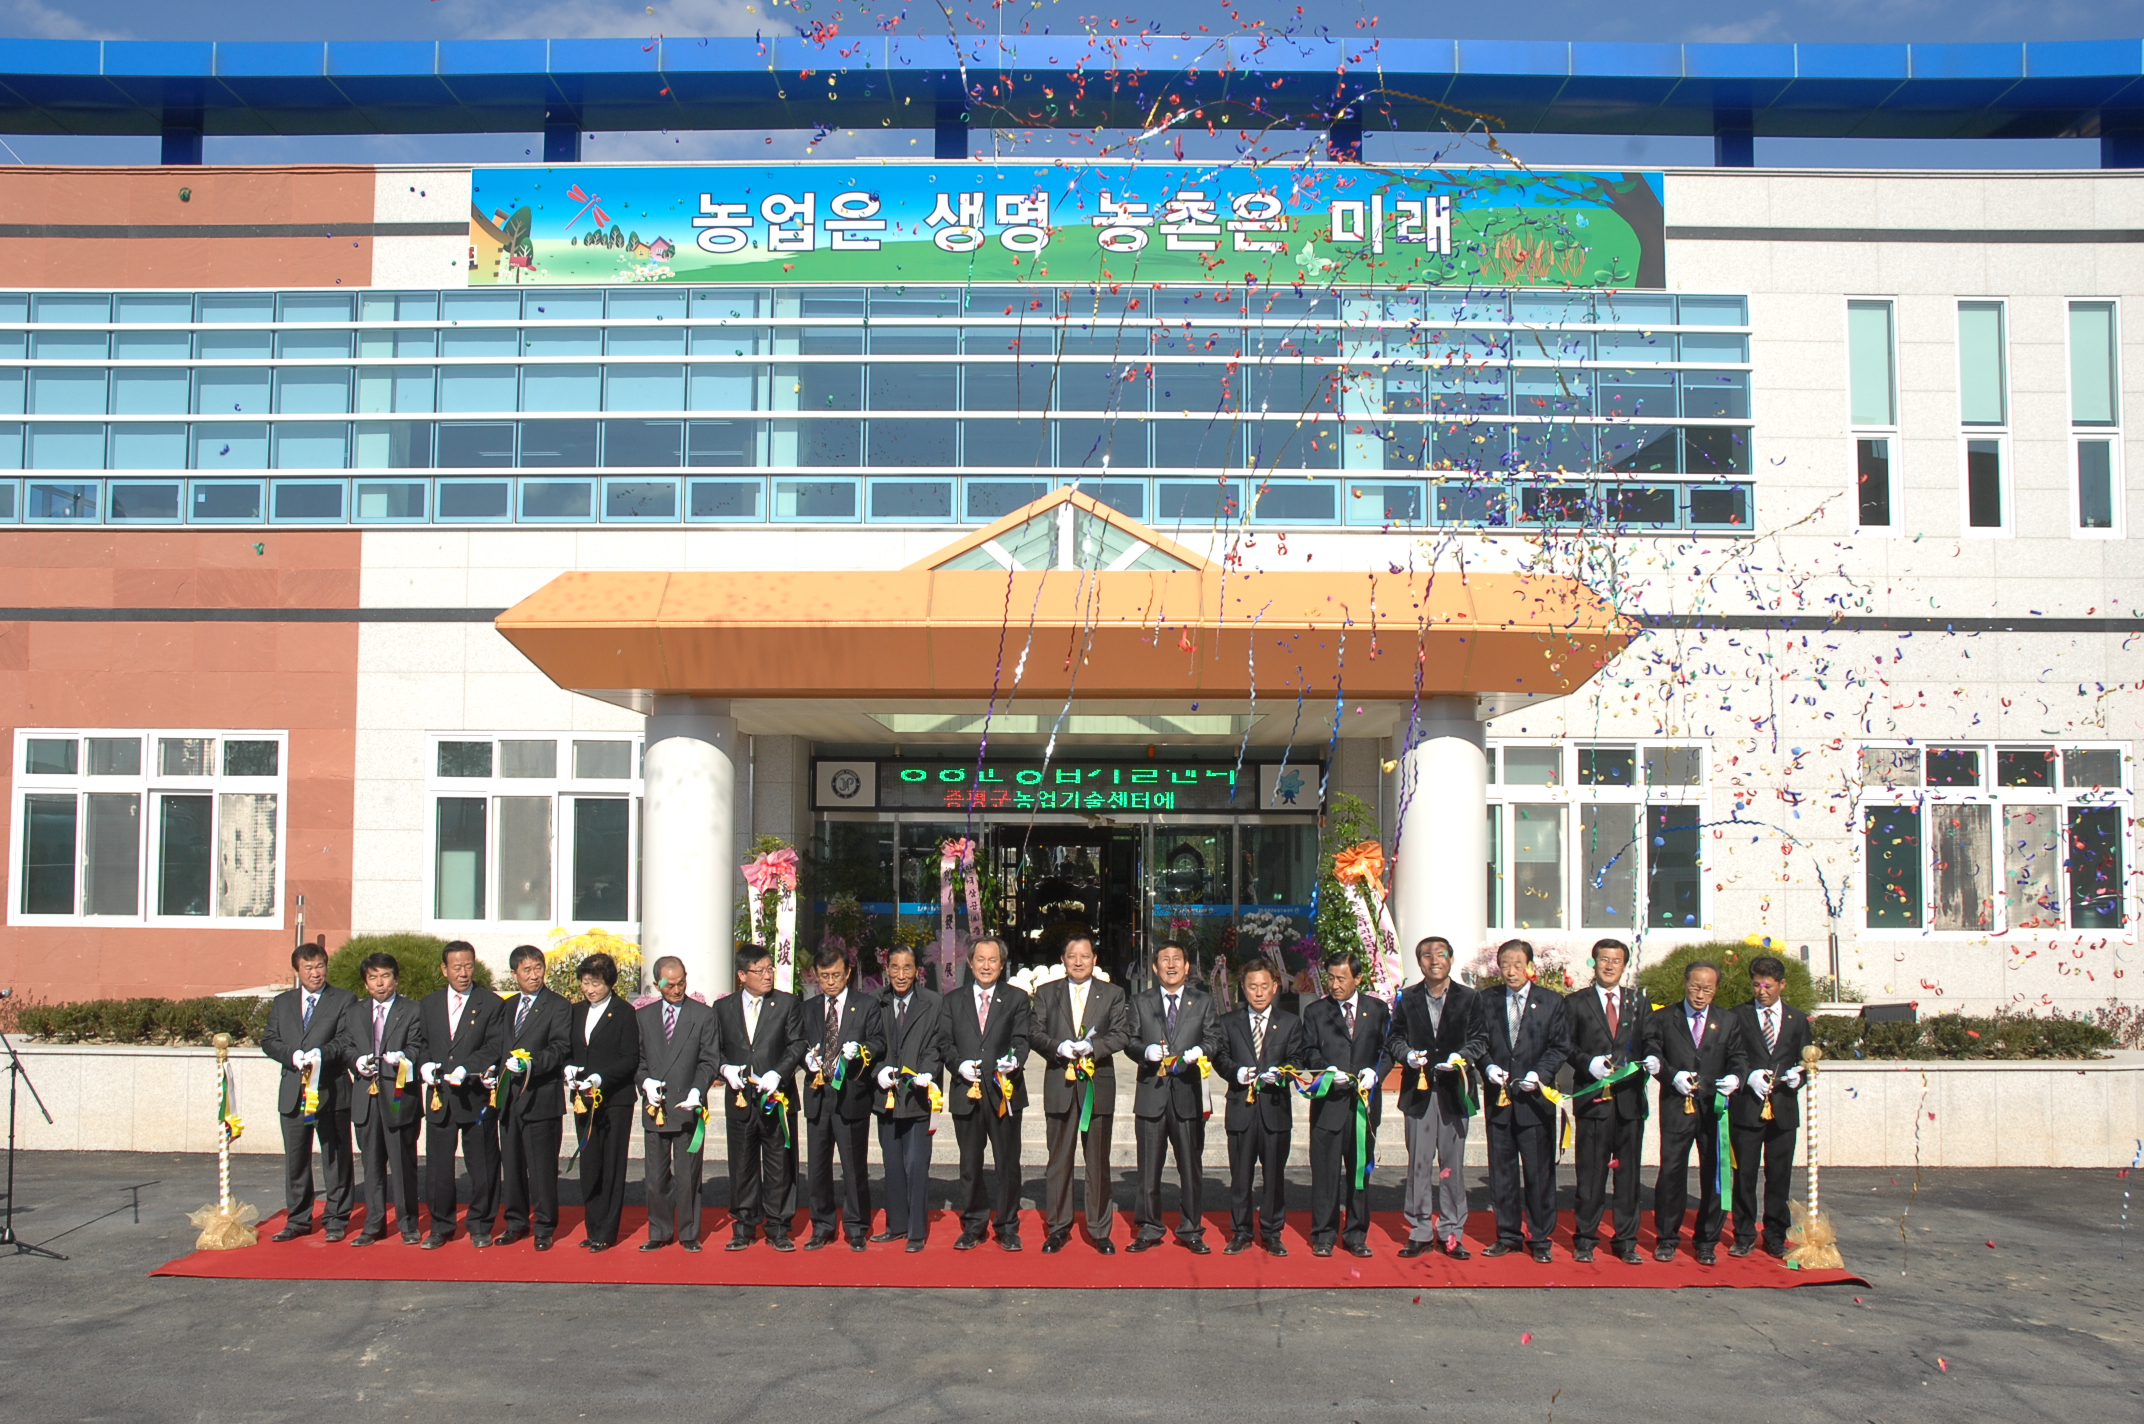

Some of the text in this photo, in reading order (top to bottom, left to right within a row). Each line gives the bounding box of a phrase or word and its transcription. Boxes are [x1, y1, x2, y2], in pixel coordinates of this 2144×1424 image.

[691, 190, 1452, 256] 농업은 생명 농촌은 미래
